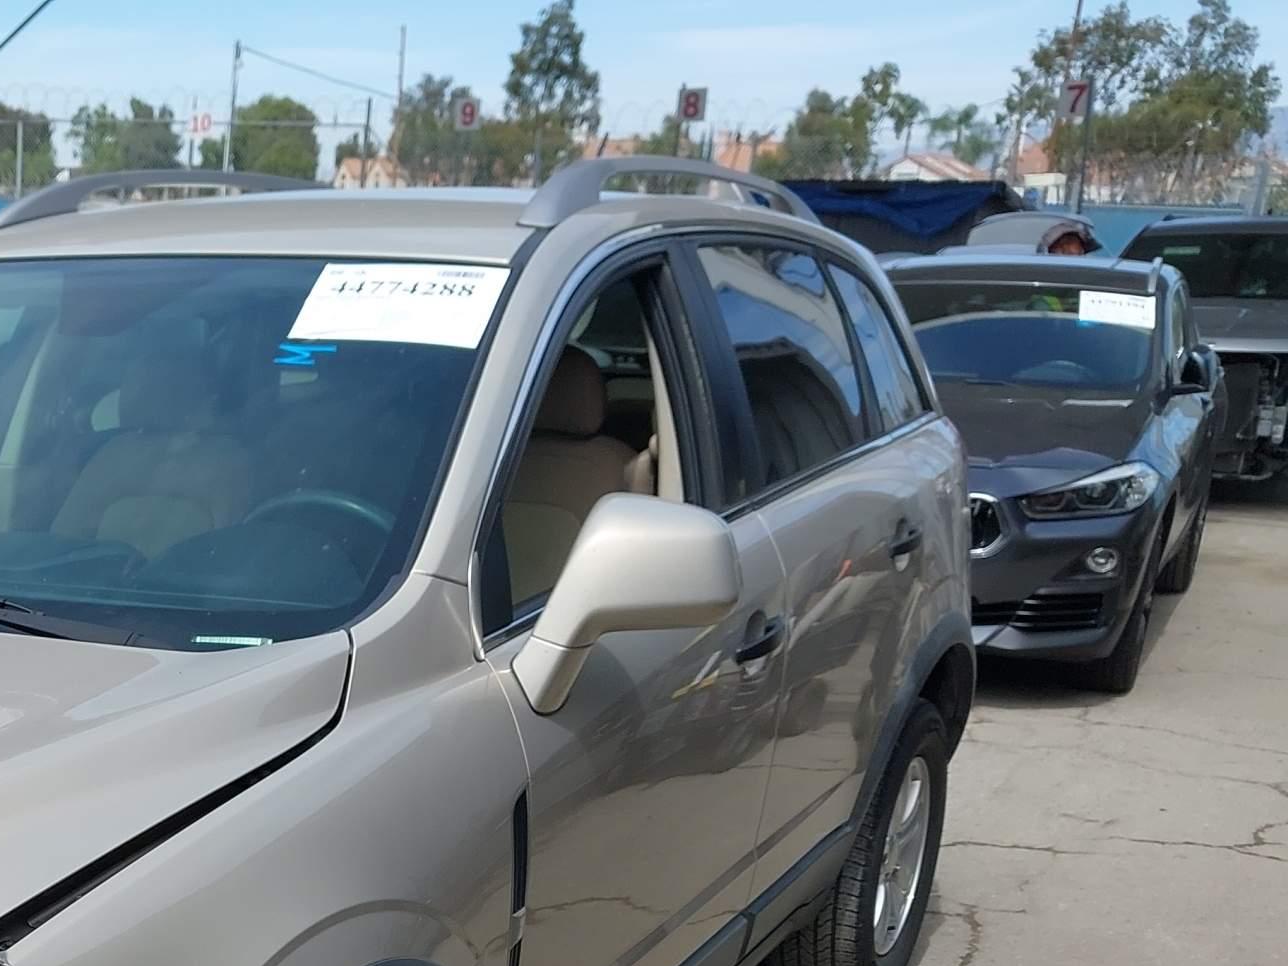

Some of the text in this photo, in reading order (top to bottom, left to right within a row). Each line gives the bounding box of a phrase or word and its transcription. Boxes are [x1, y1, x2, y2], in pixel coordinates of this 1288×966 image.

[683, 91, 700, 118] 8
[1066, 84, 1088, 113] 7
[190, 114, 212, 133] 10
[462, 102, 475, 126] 9
[330, 280, 476, 297] 44774288
